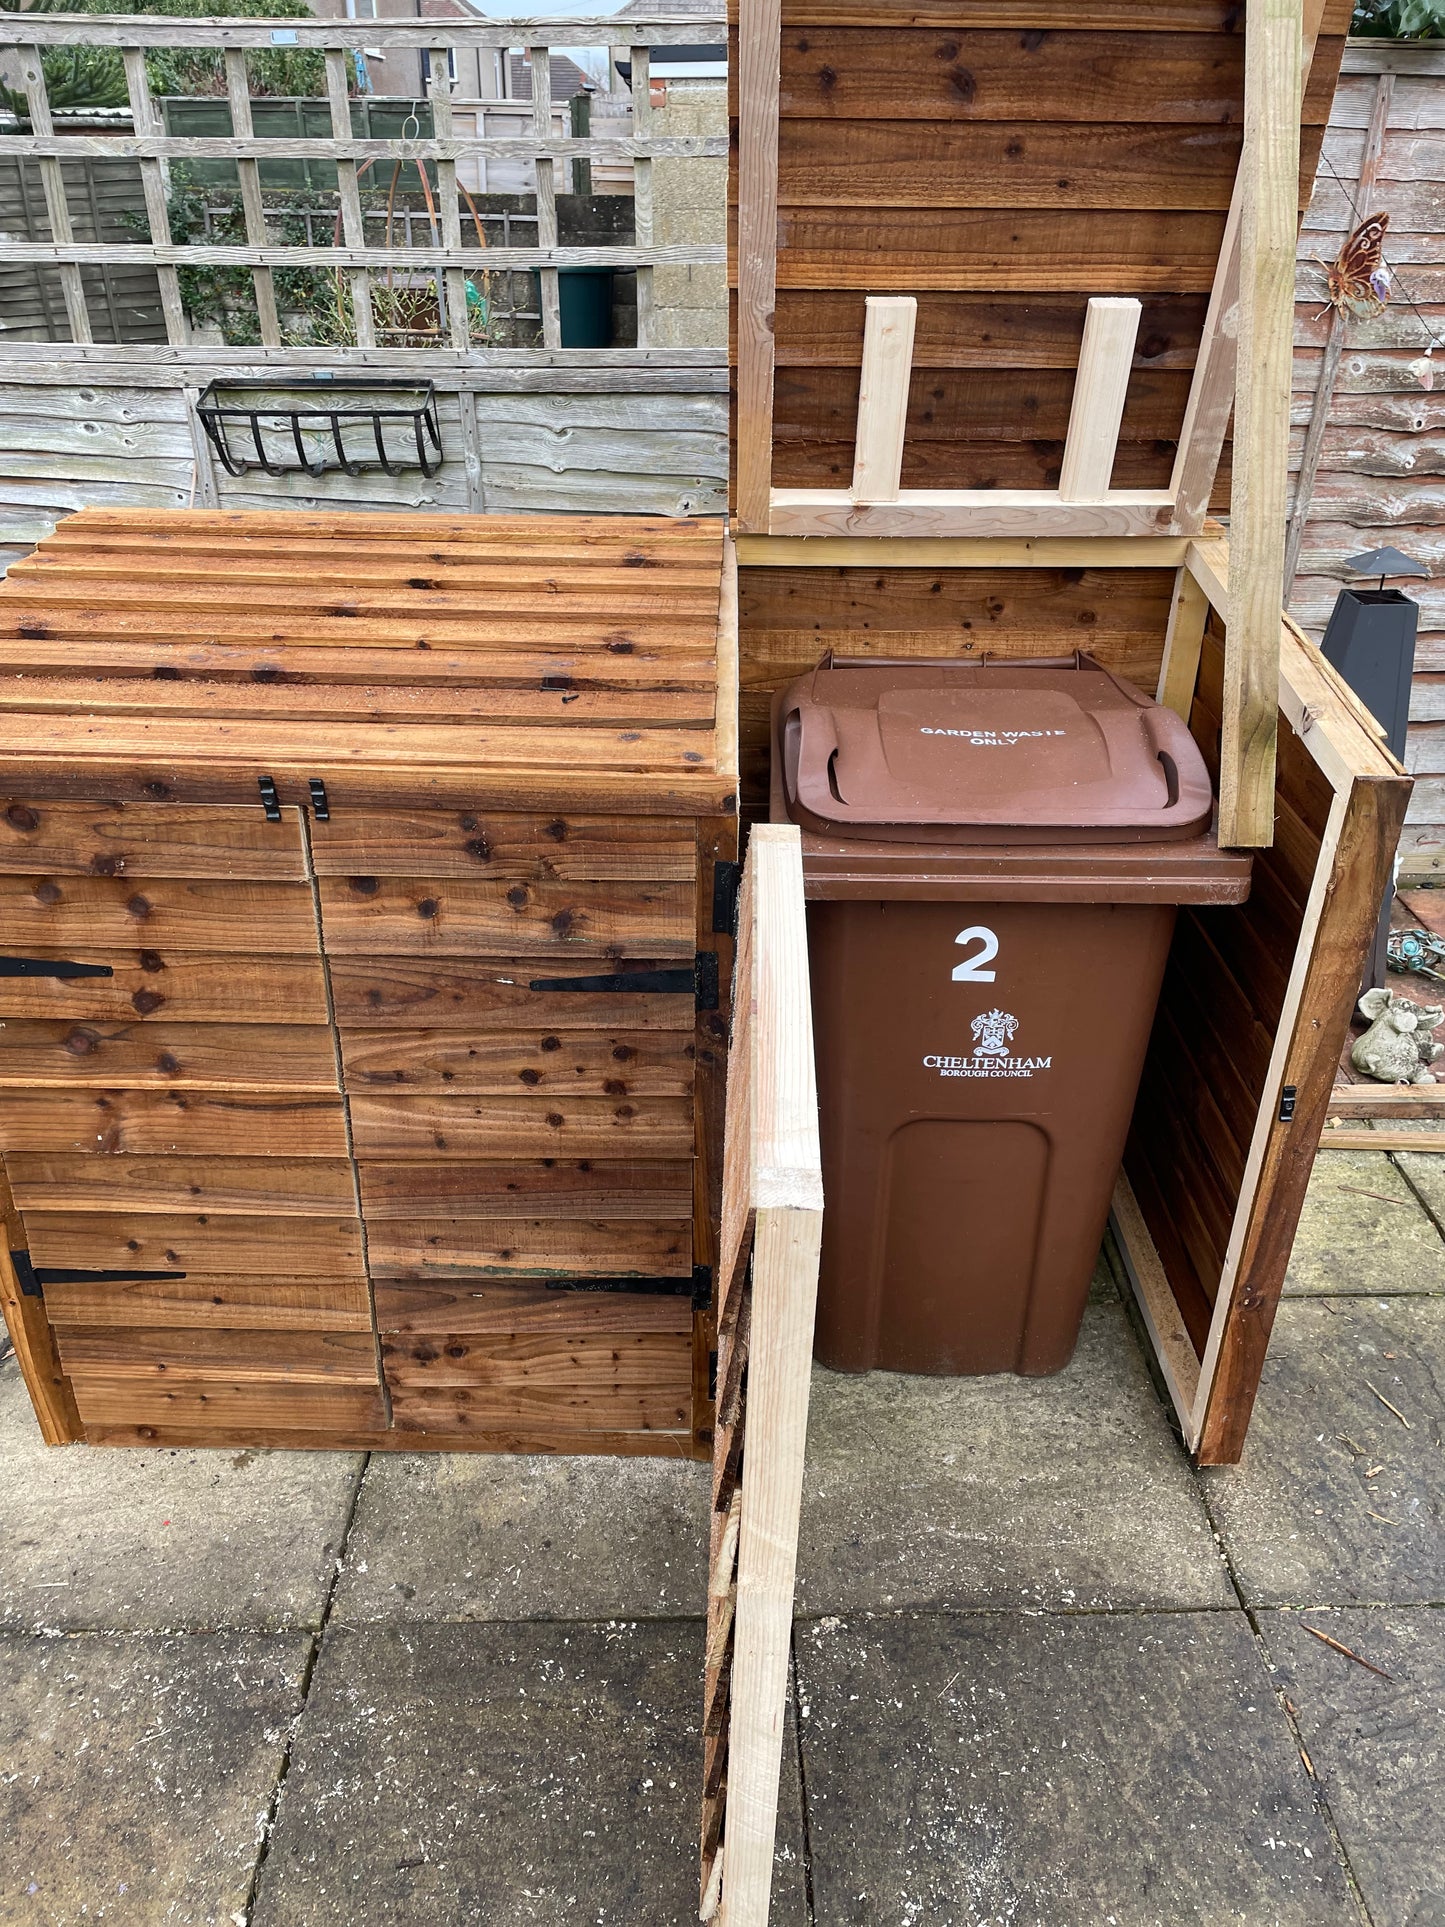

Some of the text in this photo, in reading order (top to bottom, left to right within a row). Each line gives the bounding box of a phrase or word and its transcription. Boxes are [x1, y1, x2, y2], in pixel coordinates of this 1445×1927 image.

[920, 727, 1067, 738] GARDEN WASTE
[970, 738, 1018, 746] ONLY
[951, 925, 999, 983] 2
[923, 1055, 1053, 1070] CHELTENHAM
[940, 1069, 1034, 1078] BOROUGH COUNCIL
